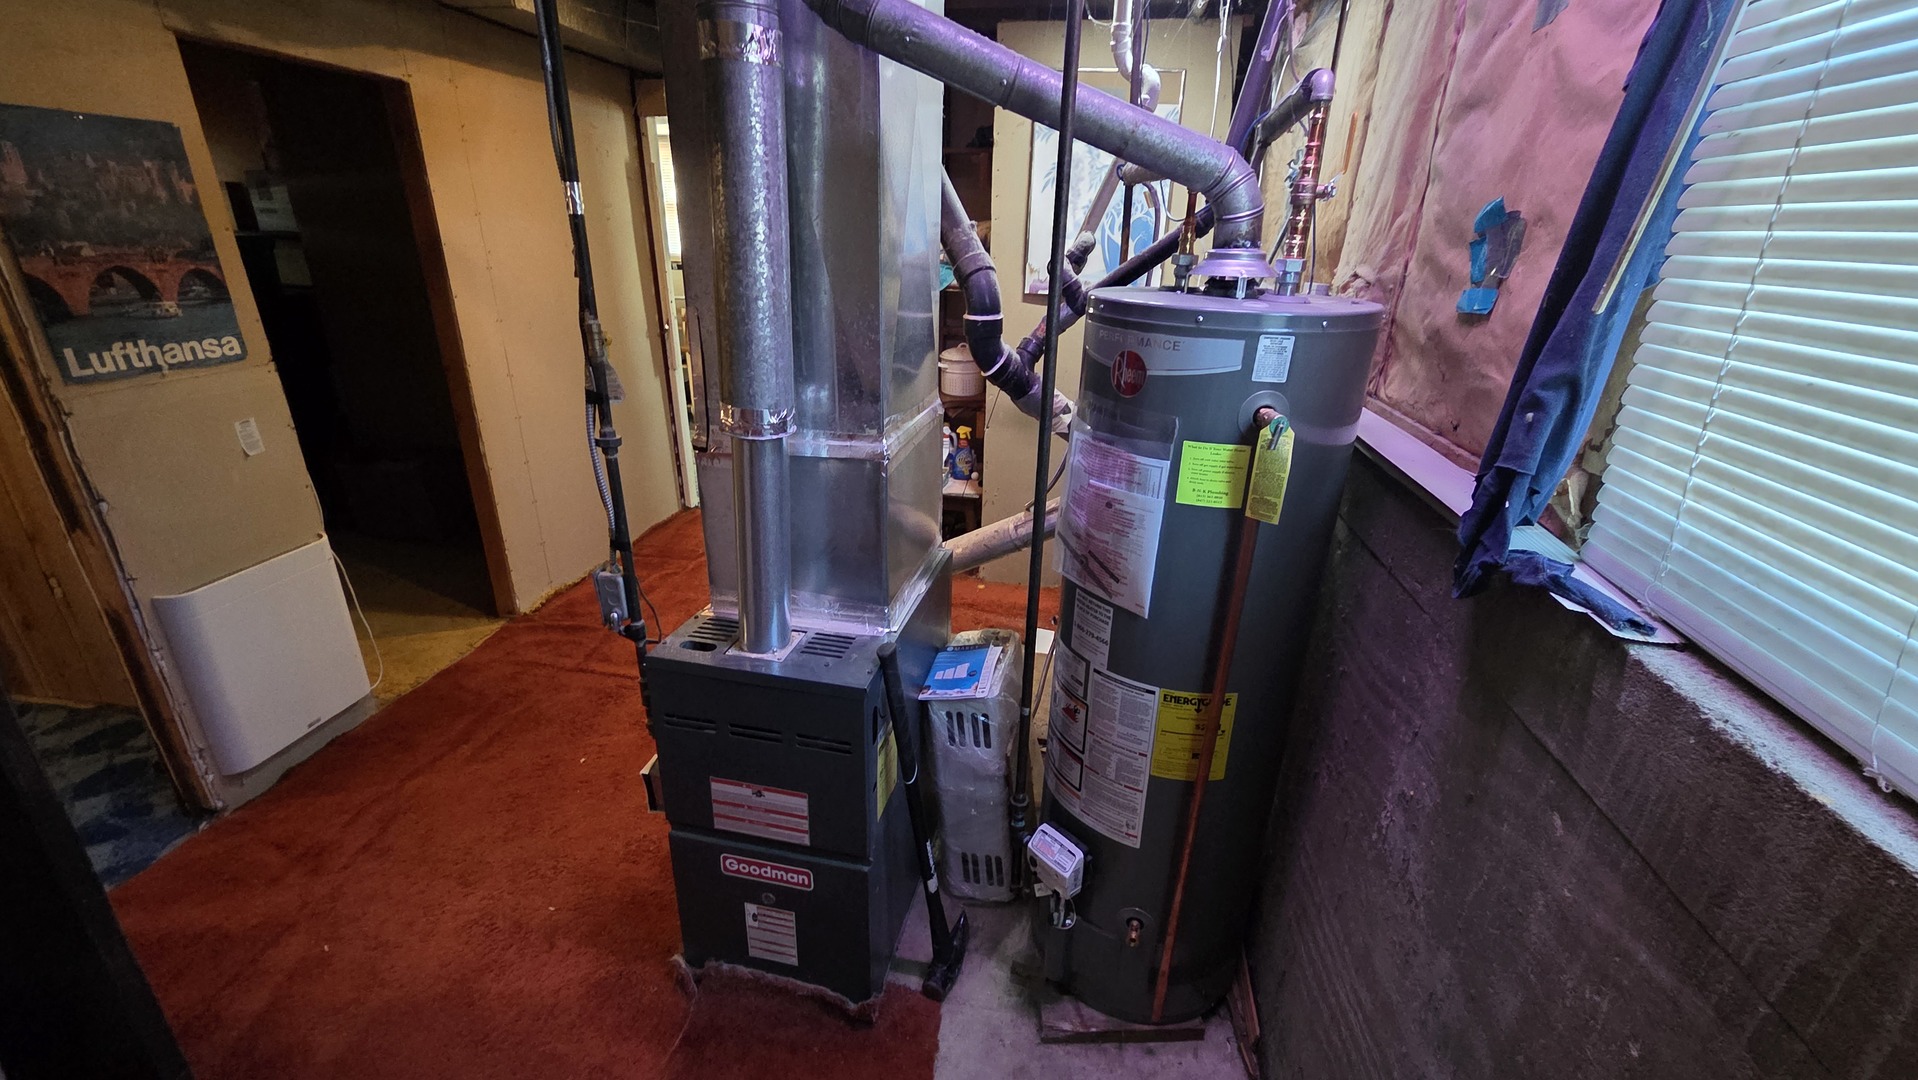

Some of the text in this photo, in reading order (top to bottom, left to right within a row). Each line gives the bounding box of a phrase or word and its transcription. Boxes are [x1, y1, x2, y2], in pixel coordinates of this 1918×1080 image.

[63, 336, 242, 378] Lufthansa
[1114, 350, 1145, 388] Rheem
[1163, 694, 1232, 710] ENERGYGE
[725, 858, 809, 886] Goodman
